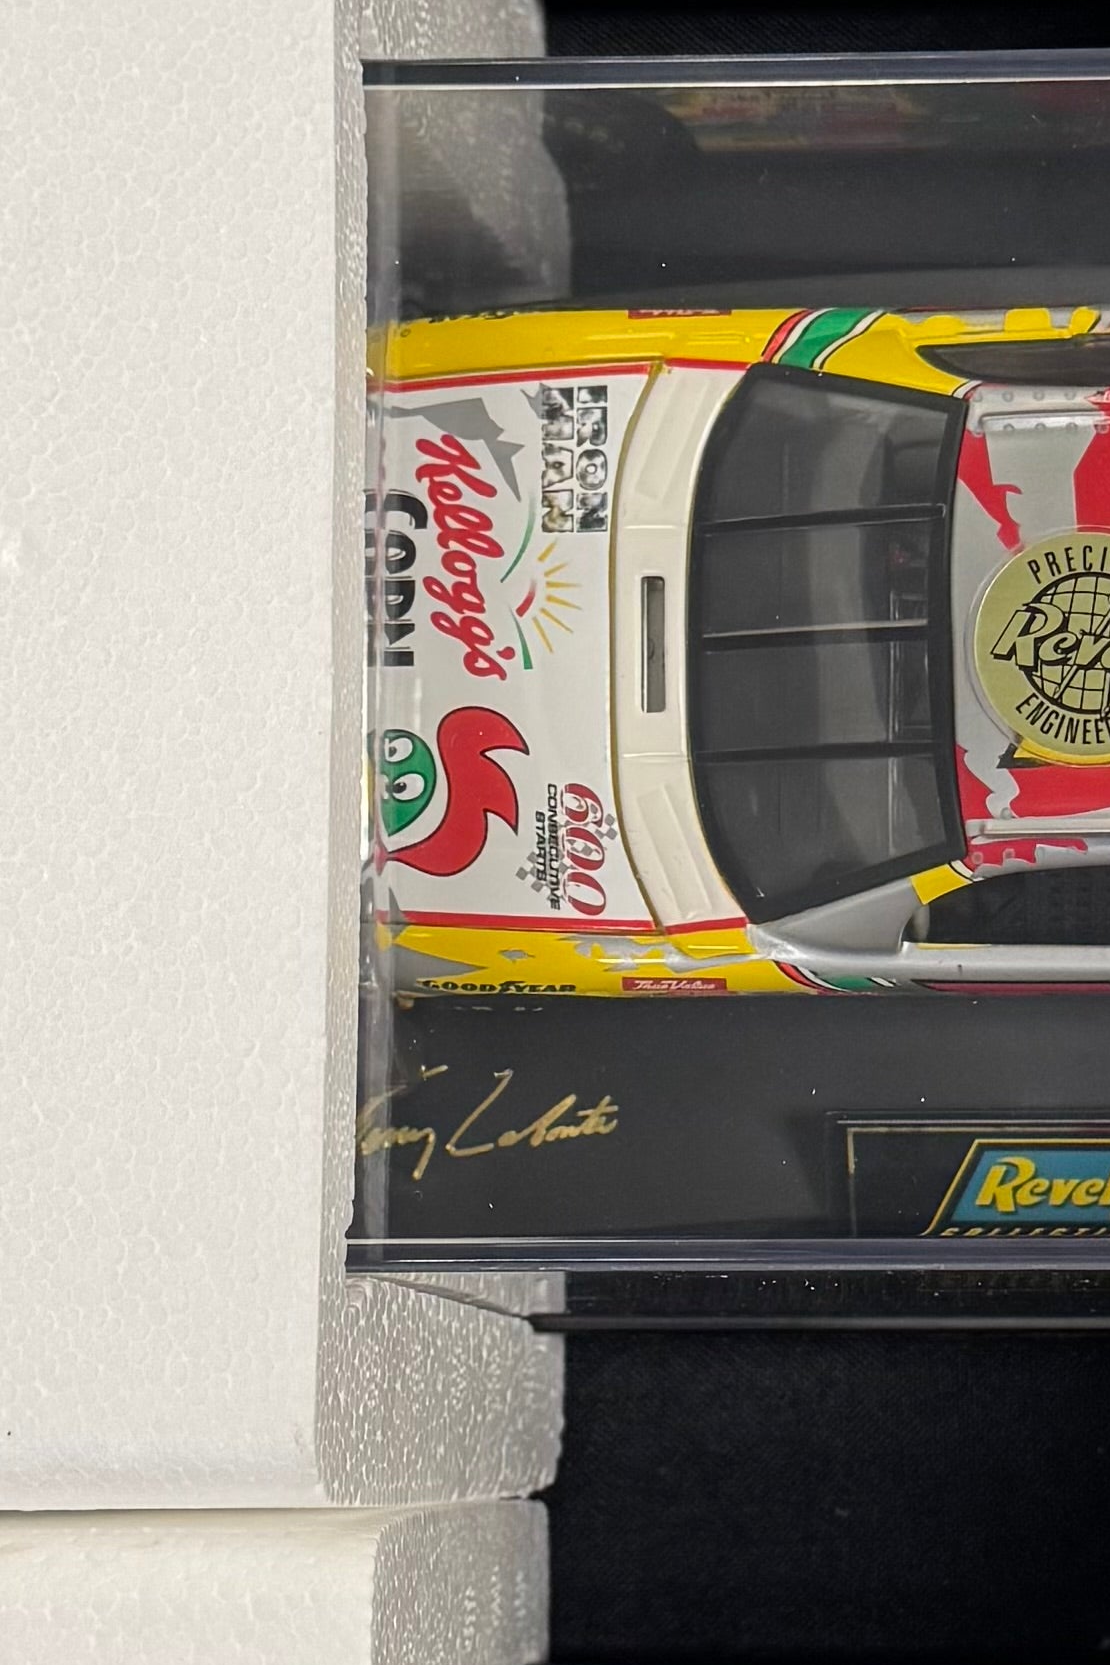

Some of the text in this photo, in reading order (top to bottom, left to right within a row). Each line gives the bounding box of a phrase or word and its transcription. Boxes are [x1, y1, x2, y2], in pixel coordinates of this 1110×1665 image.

[540, 385, 575, 534] MAN
[576, 384, 609, 534] IRON
[414, 433, 515, 681] Kellogg's
[562, 782, 607, 916] 600
[421, 979, 577, 993] GOODYEAR
